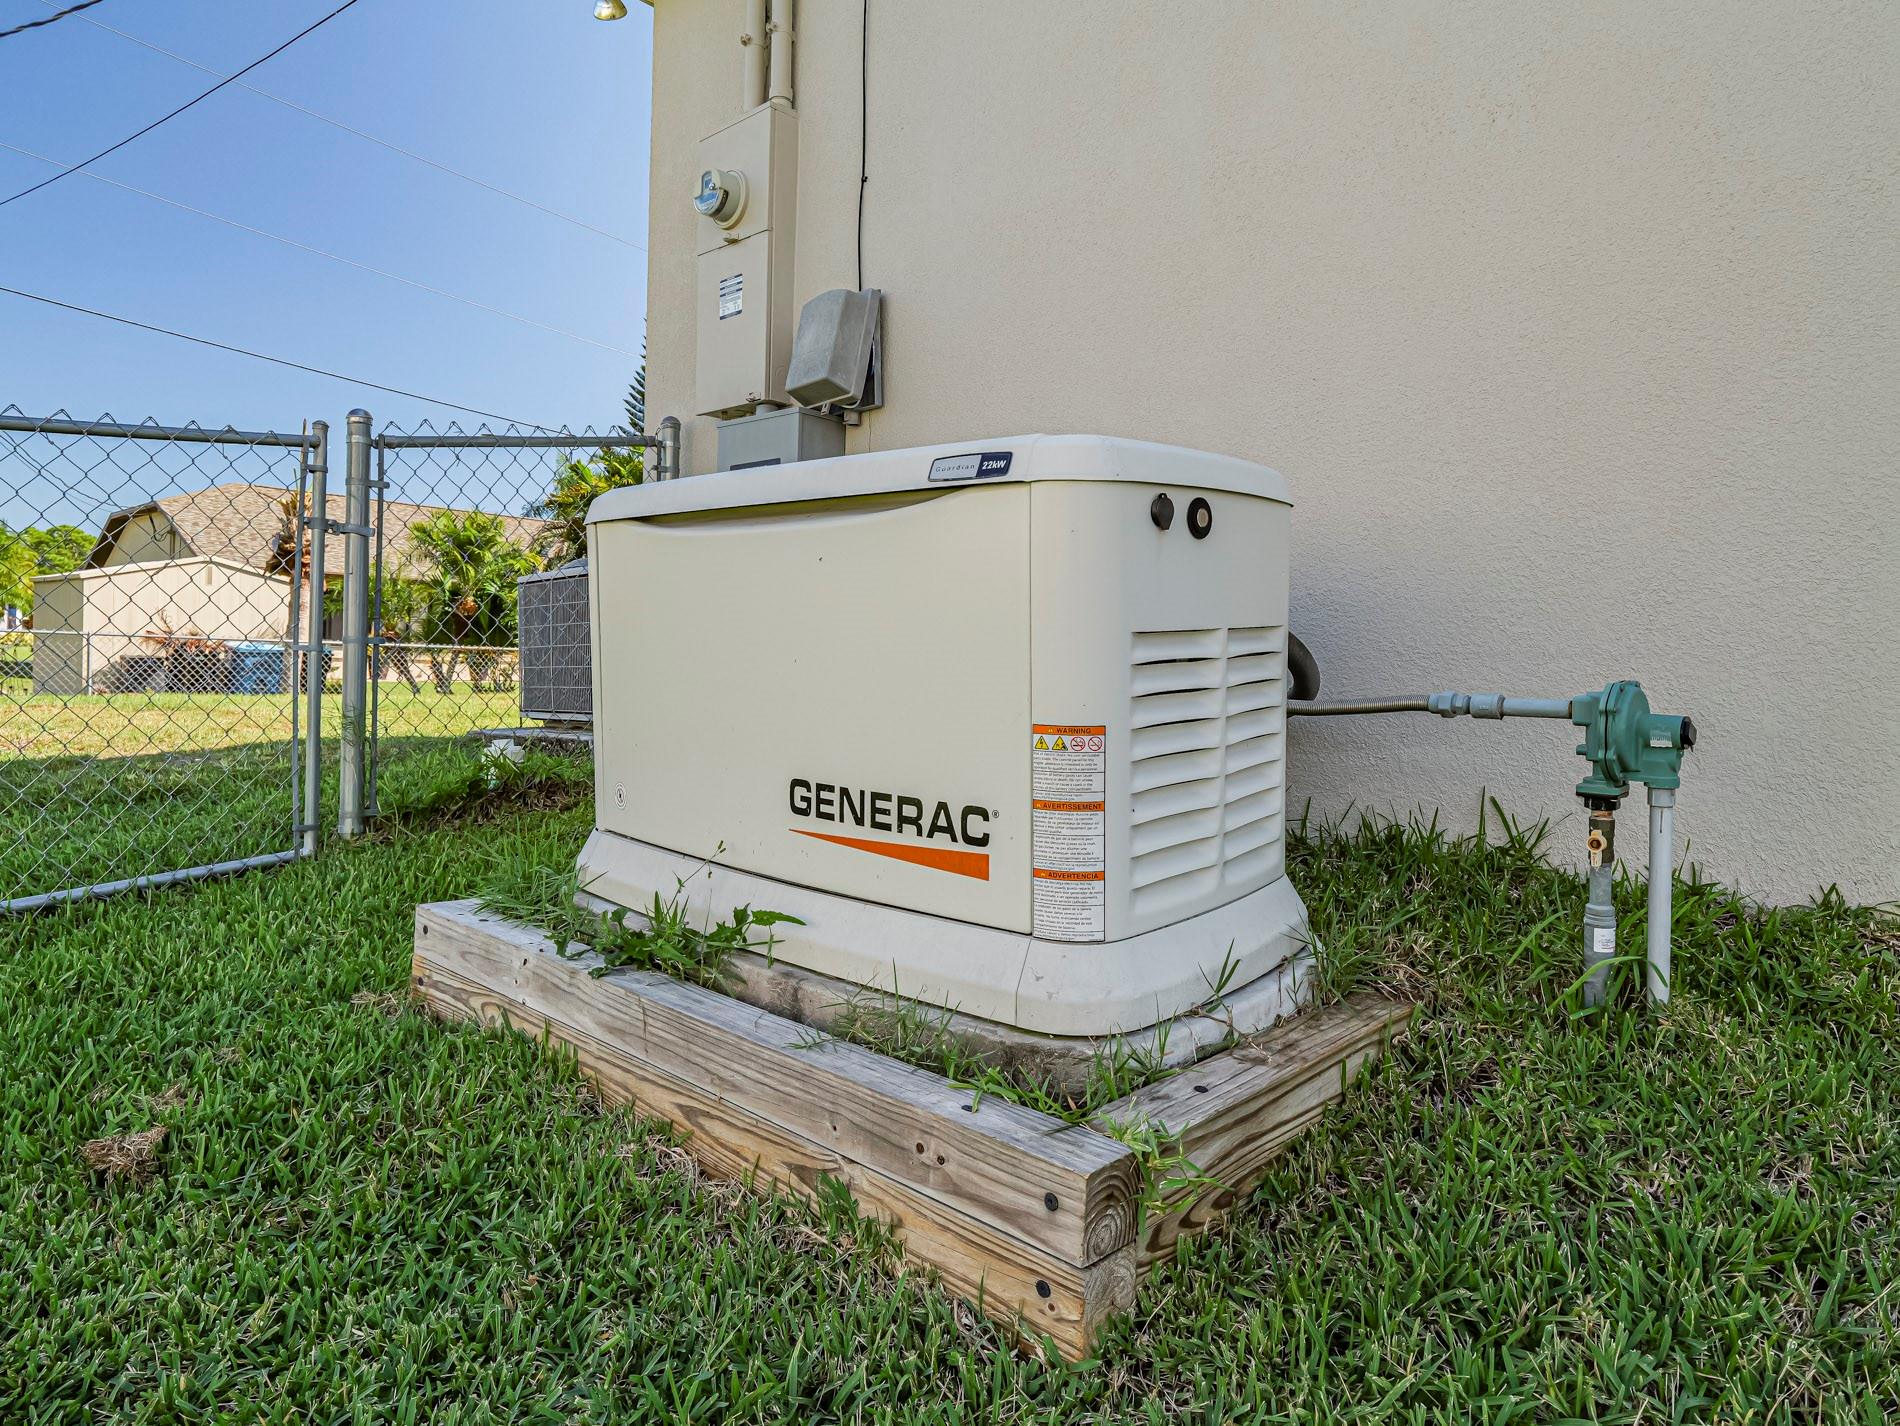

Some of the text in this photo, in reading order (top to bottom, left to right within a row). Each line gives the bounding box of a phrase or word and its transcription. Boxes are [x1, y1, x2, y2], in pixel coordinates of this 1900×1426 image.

[935, 459, 1007, 473] Guardian 22kW
[1043, 802, 1102, 811] AVERTISSEMENT
[1048, 871, 1099, 880] ADVERTENCIA
